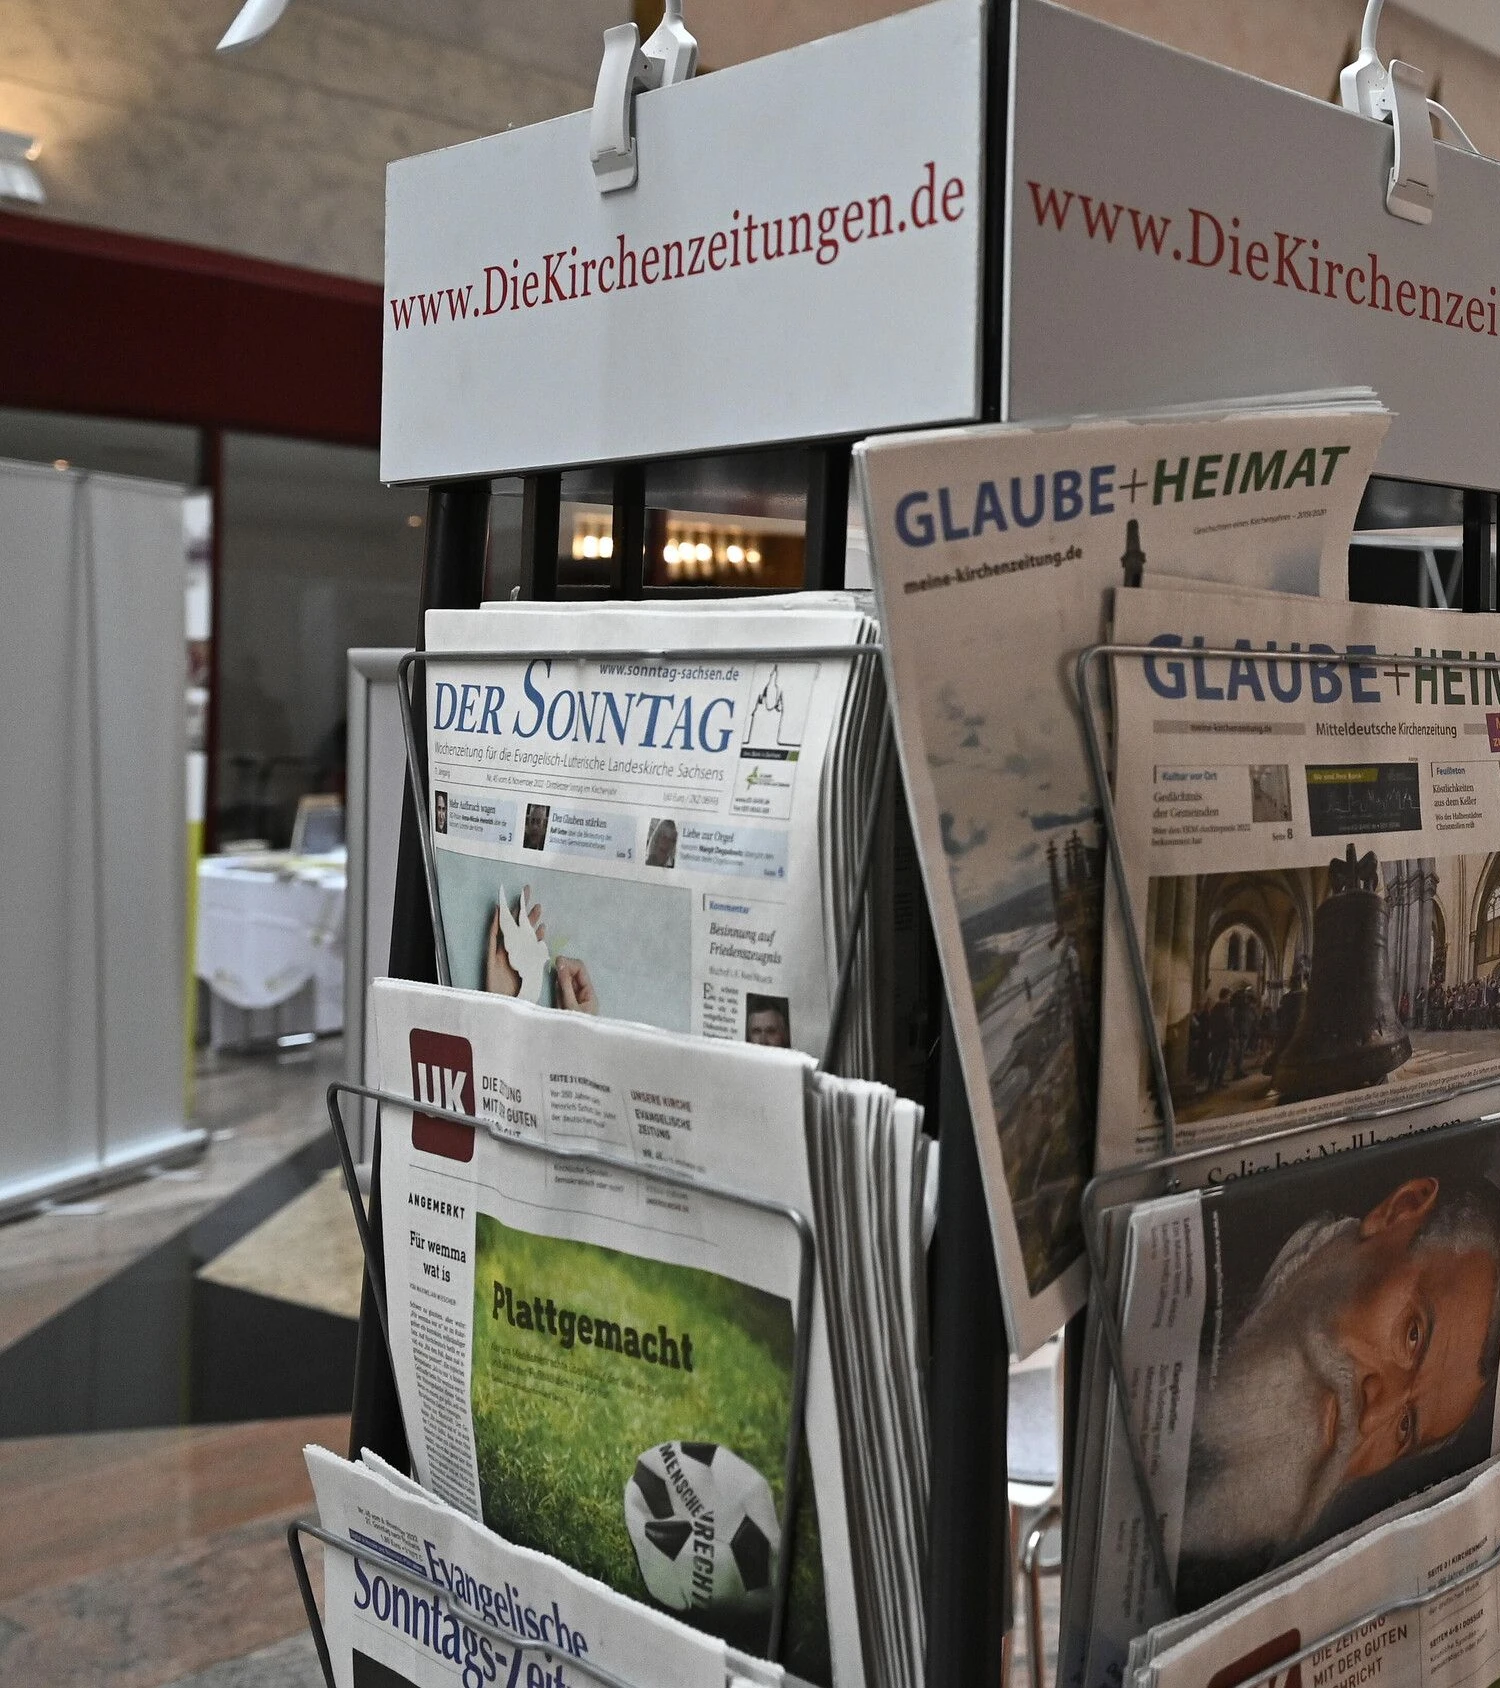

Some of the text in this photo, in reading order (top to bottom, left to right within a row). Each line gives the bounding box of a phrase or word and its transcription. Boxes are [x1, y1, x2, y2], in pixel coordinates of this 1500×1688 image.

[390, 161, 966, 331] www.DieKirchenzeitungen.de
[903, 545, 1083, 594] meine-kirchenzeitung.de
[600, 663, 740, 682] www.sonntag-sachsen.de
[433, 658, 736, 752] DER SONNTAG
[1316, 722, 1457, 738] Mitteldeutsche Kirchenzeitung
[434, 742, 484, 762] Wochenzeitung
[485, 745, 497, 760] für
[500, 748, 512, 761] die
[608, 756, 674, 777] Landeskirche
[677, 763, 724, 781] Sachsens
[1287, 828, 1293, 839] 8
[710, 922, 776, 947] Besinnung auf
[416, 1062, 468, 1117] UK
[482, 1076, 498, 1091] DIE
[482, 1096, 498, 1113] MIT
[507, 1107, 537, 1129] GUTEN
[408, 1192, 465, 1219] ANGEMERKT
[410, 1230, 467, 1264] Für wemma
[423, 1262, 450, 1282] wat is
[493, 1280, 693, 1373] Plattgemacht
[1427, 1564, 1443, 1579] SEITE
[423, 1539, 589, 1657] Evangelische
[1312, 1646, 1332, 1667] DIE
[1313, 1624, 1408, 1688] MIT DER GUTEN
[1333, 1656, 1383, 1688] HRICHT
